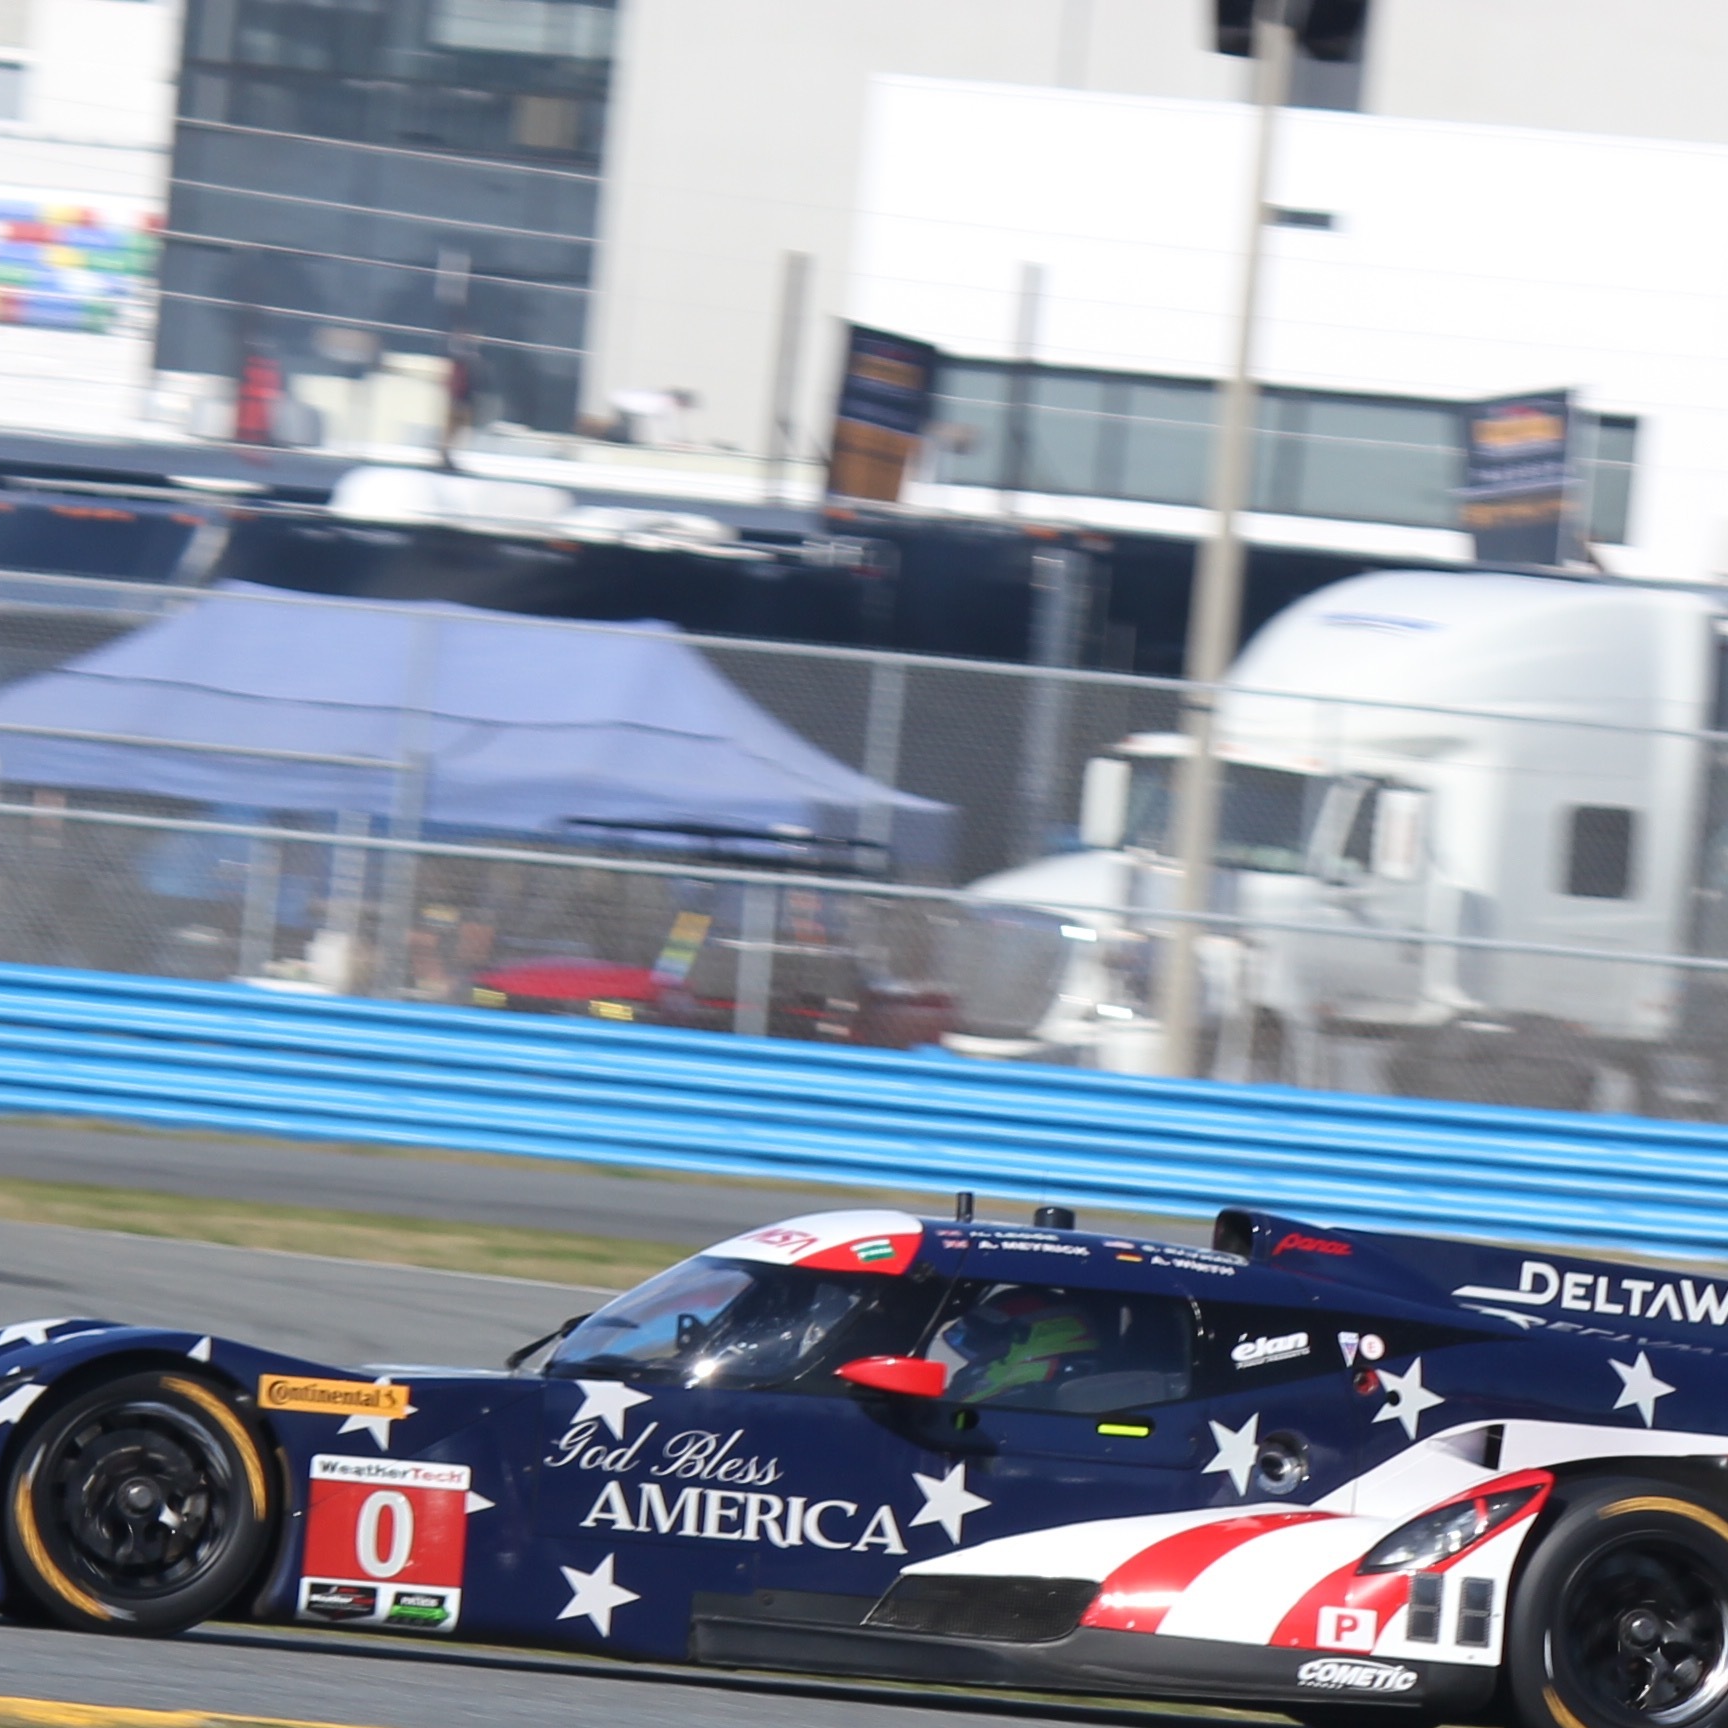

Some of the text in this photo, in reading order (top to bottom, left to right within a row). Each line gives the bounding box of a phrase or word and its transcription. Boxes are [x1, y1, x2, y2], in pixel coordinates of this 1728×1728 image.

[268, 1380, 381, 1408] Continental
[544, 1419, 784, 1487] God Bless
[320, 1459, 466, 1485] WeatherTech
[356, 1490, 415, 1579] 0
[579, 1480, 909, 1556] AMERICA
[1334, 1613, 1359, 1643] P
[1297, 1659, 1419, 1692] COMETIC
